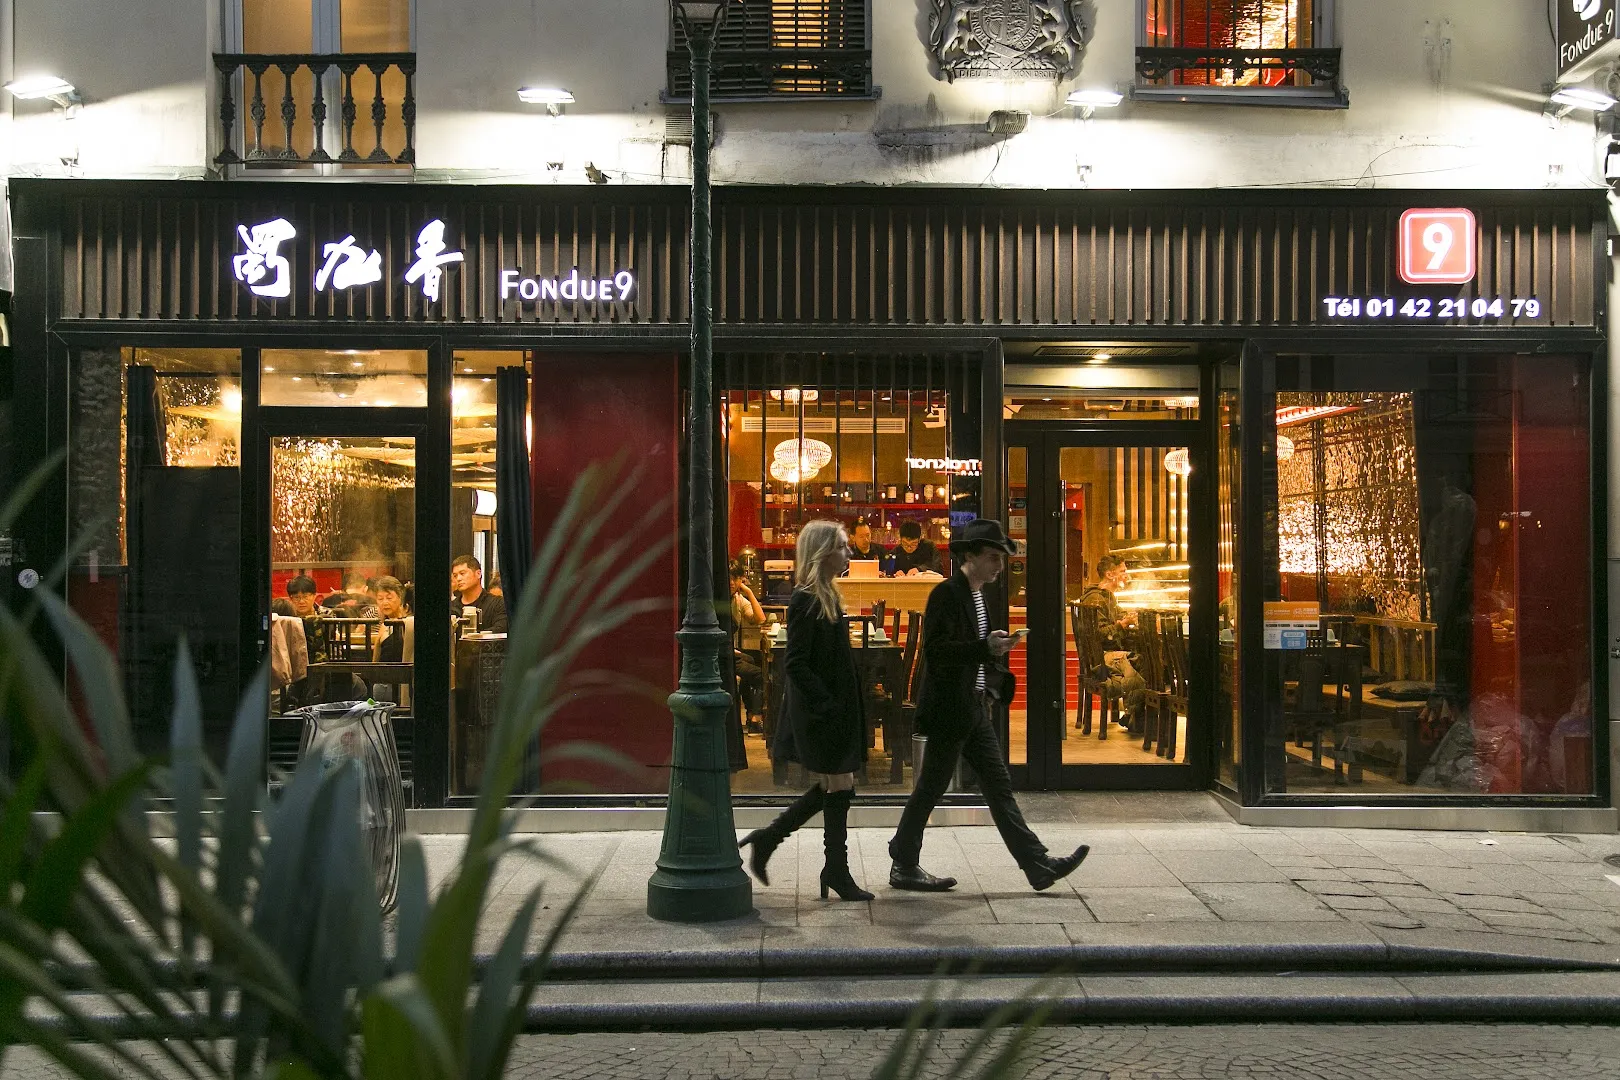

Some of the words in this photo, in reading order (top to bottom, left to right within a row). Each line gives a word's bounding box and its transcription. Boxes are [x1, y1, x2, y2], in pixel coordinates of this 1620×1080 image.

[1605, 8, 1614, 34] 9
[959, 69, 981, 78] DIEU
[1012, 70, 1032, 78] MON
[1422, 222, 1453, 270] 9
[1323, 298, 1359, 317] Tél
[1366, 299, 1394, 317] 01
[1399, 298, 1431, 317] 42
[1437, 298, 1466, 317] 21
[1471, 298, 1504, 317] 04
[1510, 298, 1540, 317] 79
